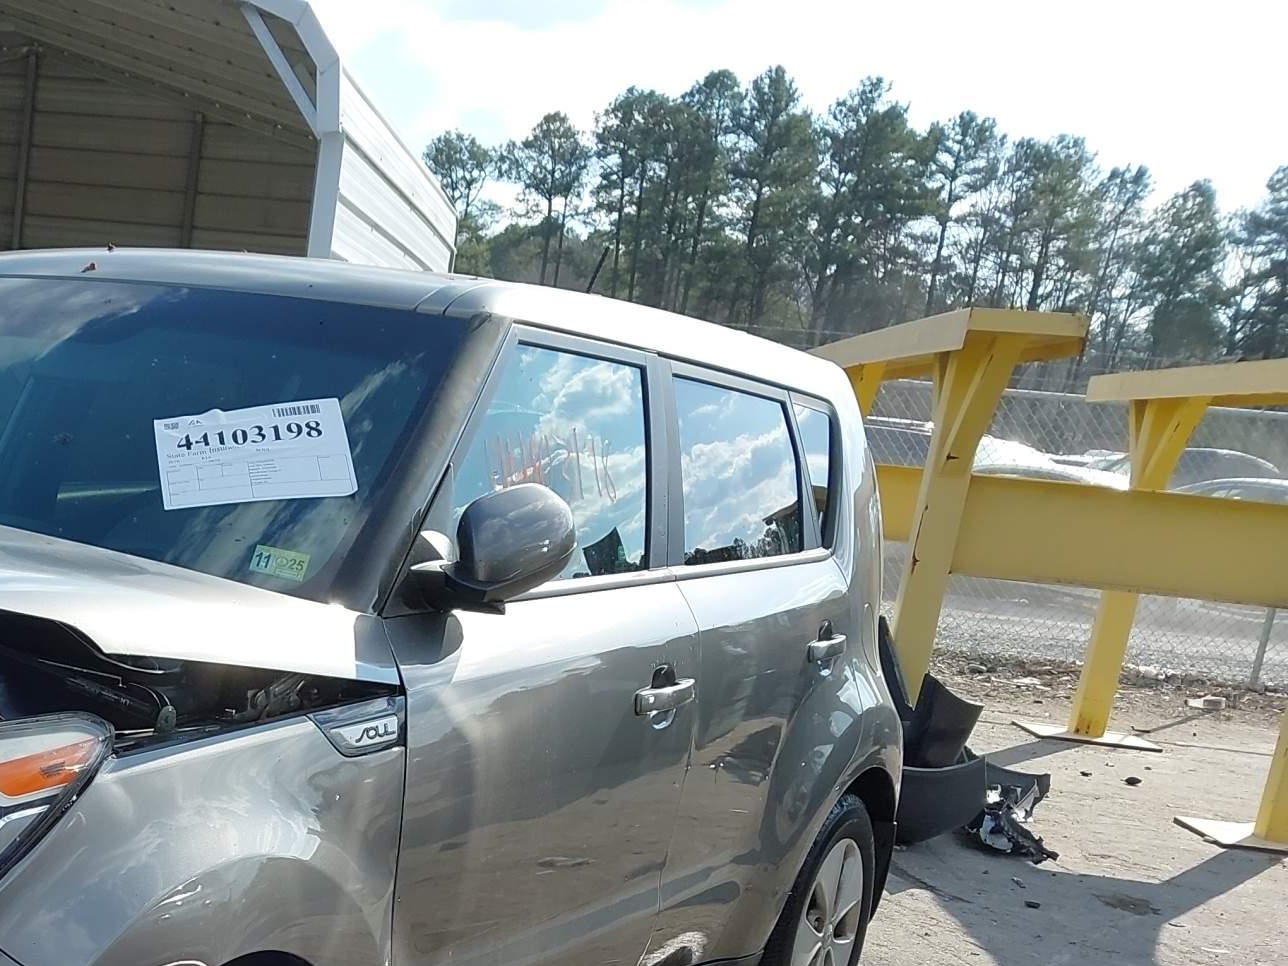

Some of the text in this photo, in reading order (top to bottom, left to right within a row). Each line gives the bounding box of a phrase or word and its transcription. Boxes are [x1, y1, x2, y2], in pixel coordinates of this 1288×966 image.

[176, 419, 323, 451] 44103198
[255, 551, 305, 571] 11 25
[354, 722, 397, 744] SOUL
